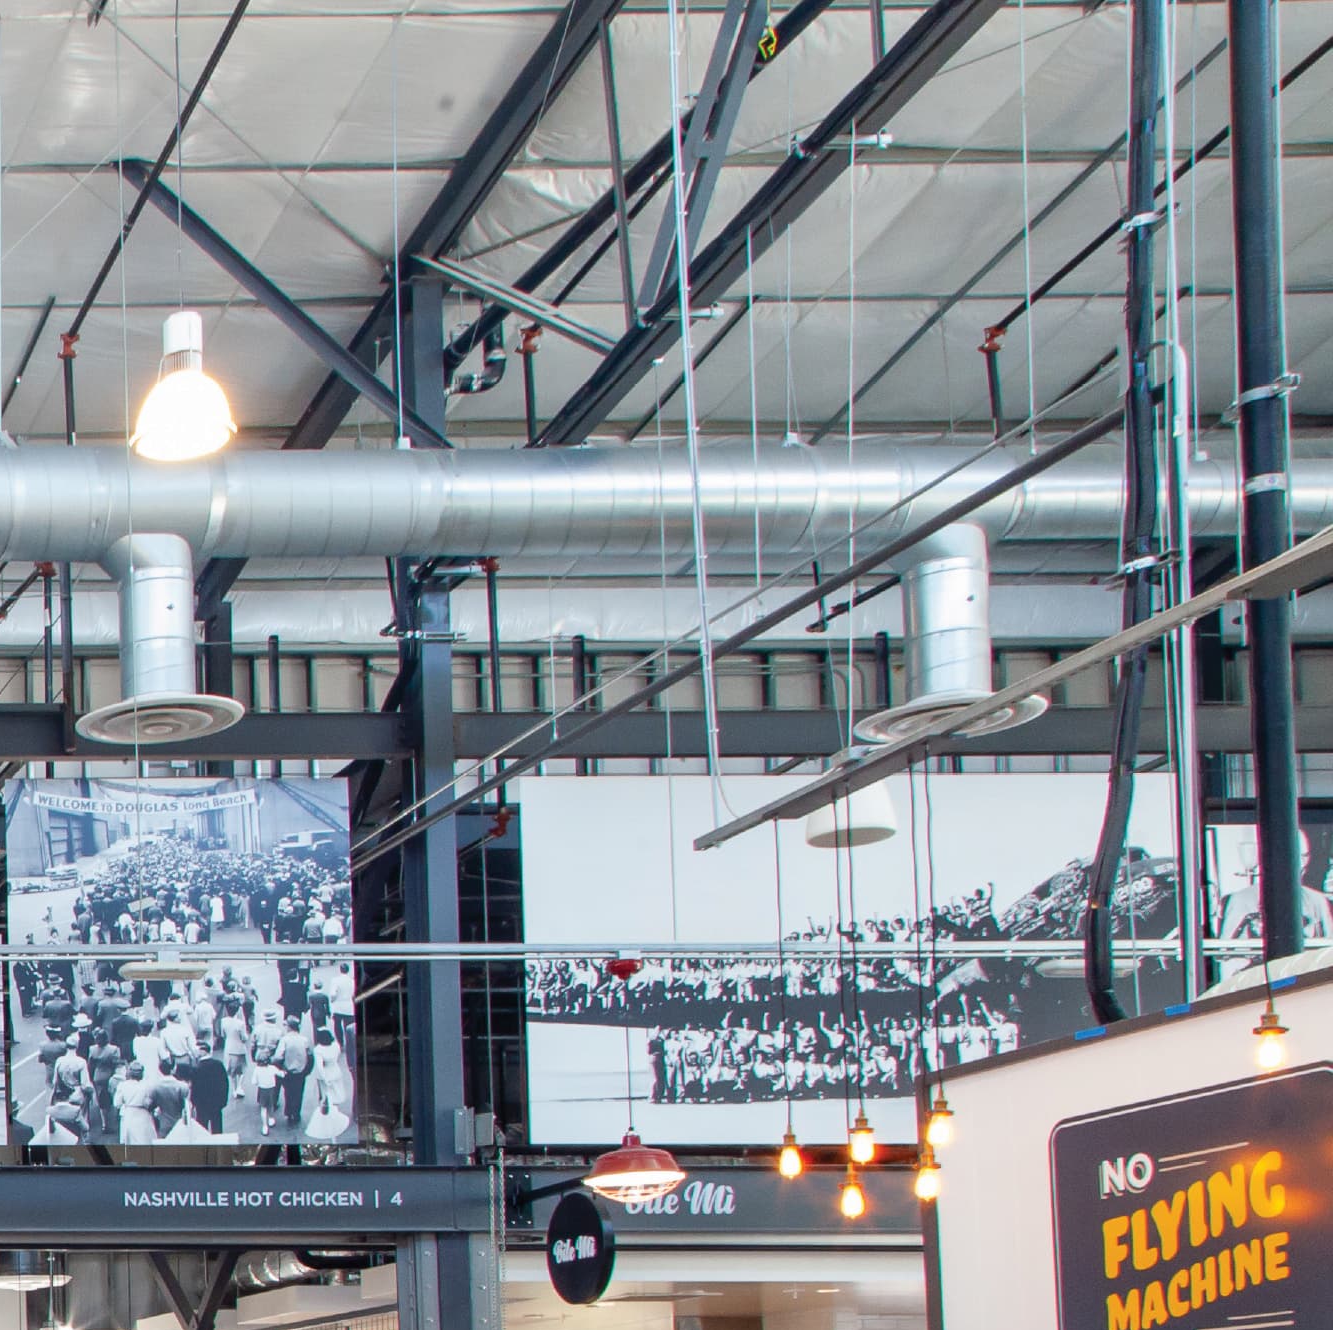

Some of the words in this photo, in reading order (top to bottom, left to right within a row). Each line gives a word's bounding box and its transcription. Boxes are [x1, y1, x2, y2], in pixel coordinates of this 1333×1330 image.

[37, 793, 98, 811] WELCOME
[115, 801, 179, 813] DOUGLAS
[1099, 1152, 1155, 1199] NO
[124, 1192, 229, 1207] NASHVILLE
[234, 1192, 274, 1207] HOT
[278, 1191, 364, 1207] CHICKEN
[390, 1191, 403, 1207] 4
[1102, 1150, 1286, 1280] FLYING
